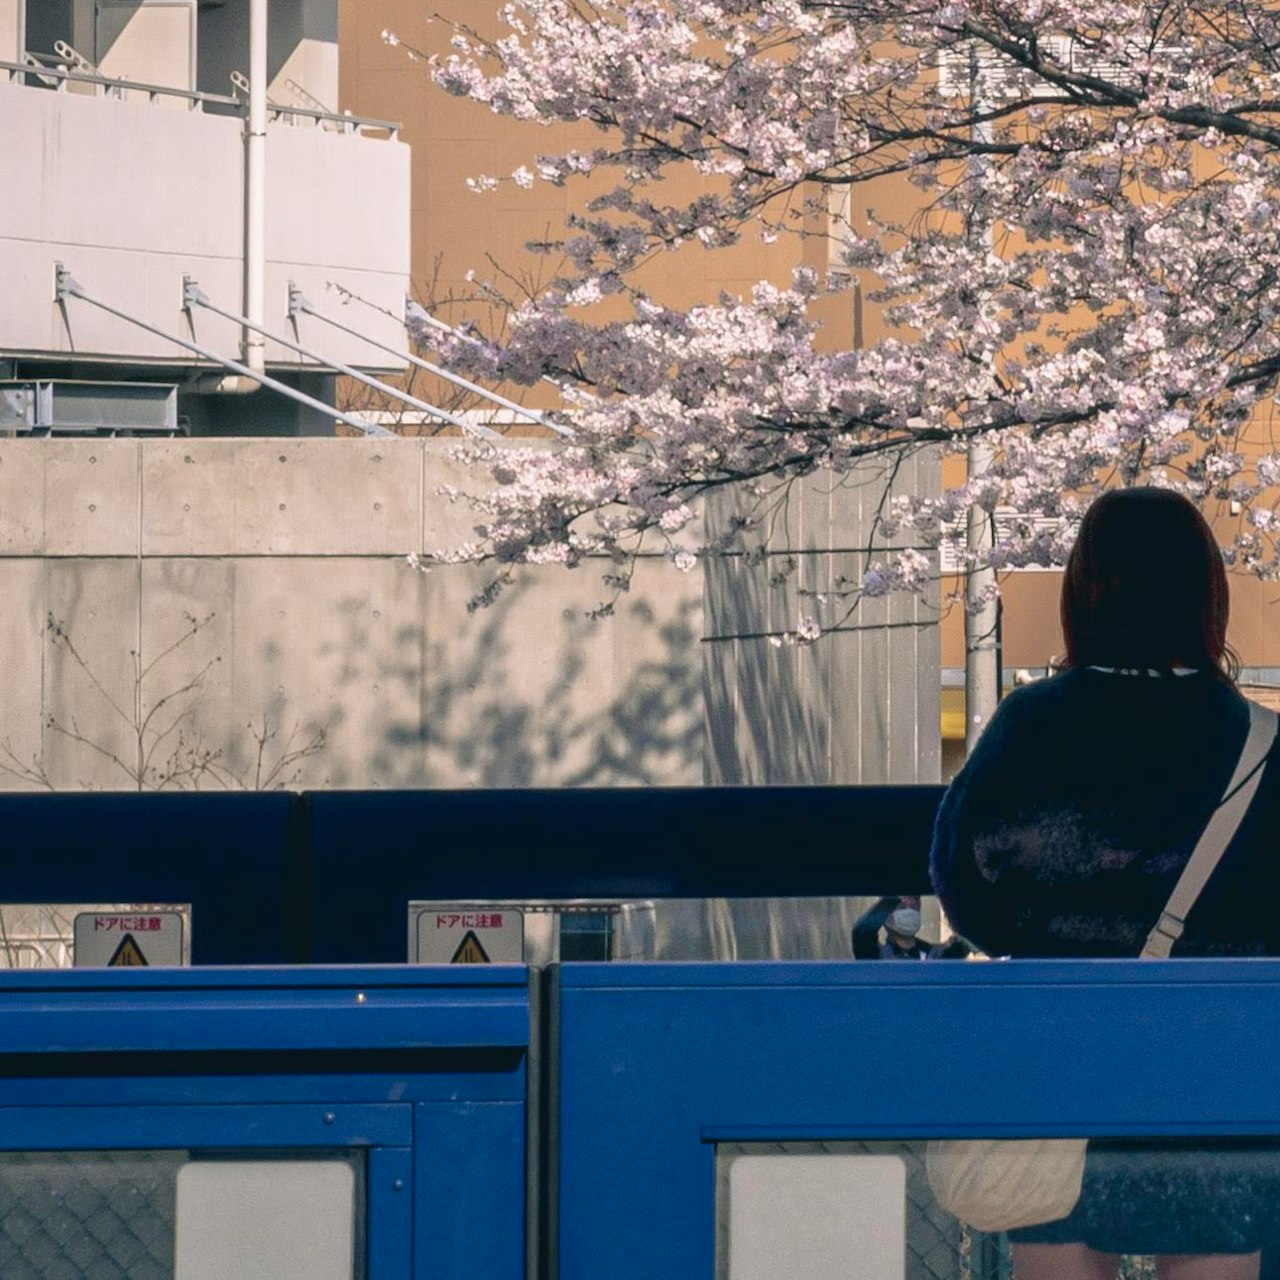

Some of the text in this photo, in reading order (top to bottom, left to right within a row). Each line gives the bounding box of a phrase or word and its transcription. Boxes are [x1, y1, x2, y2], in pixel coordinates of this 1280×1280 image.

[94, 916, 162, 931] ドアに注意
[436, 913, 503, 929] ドアに注意
